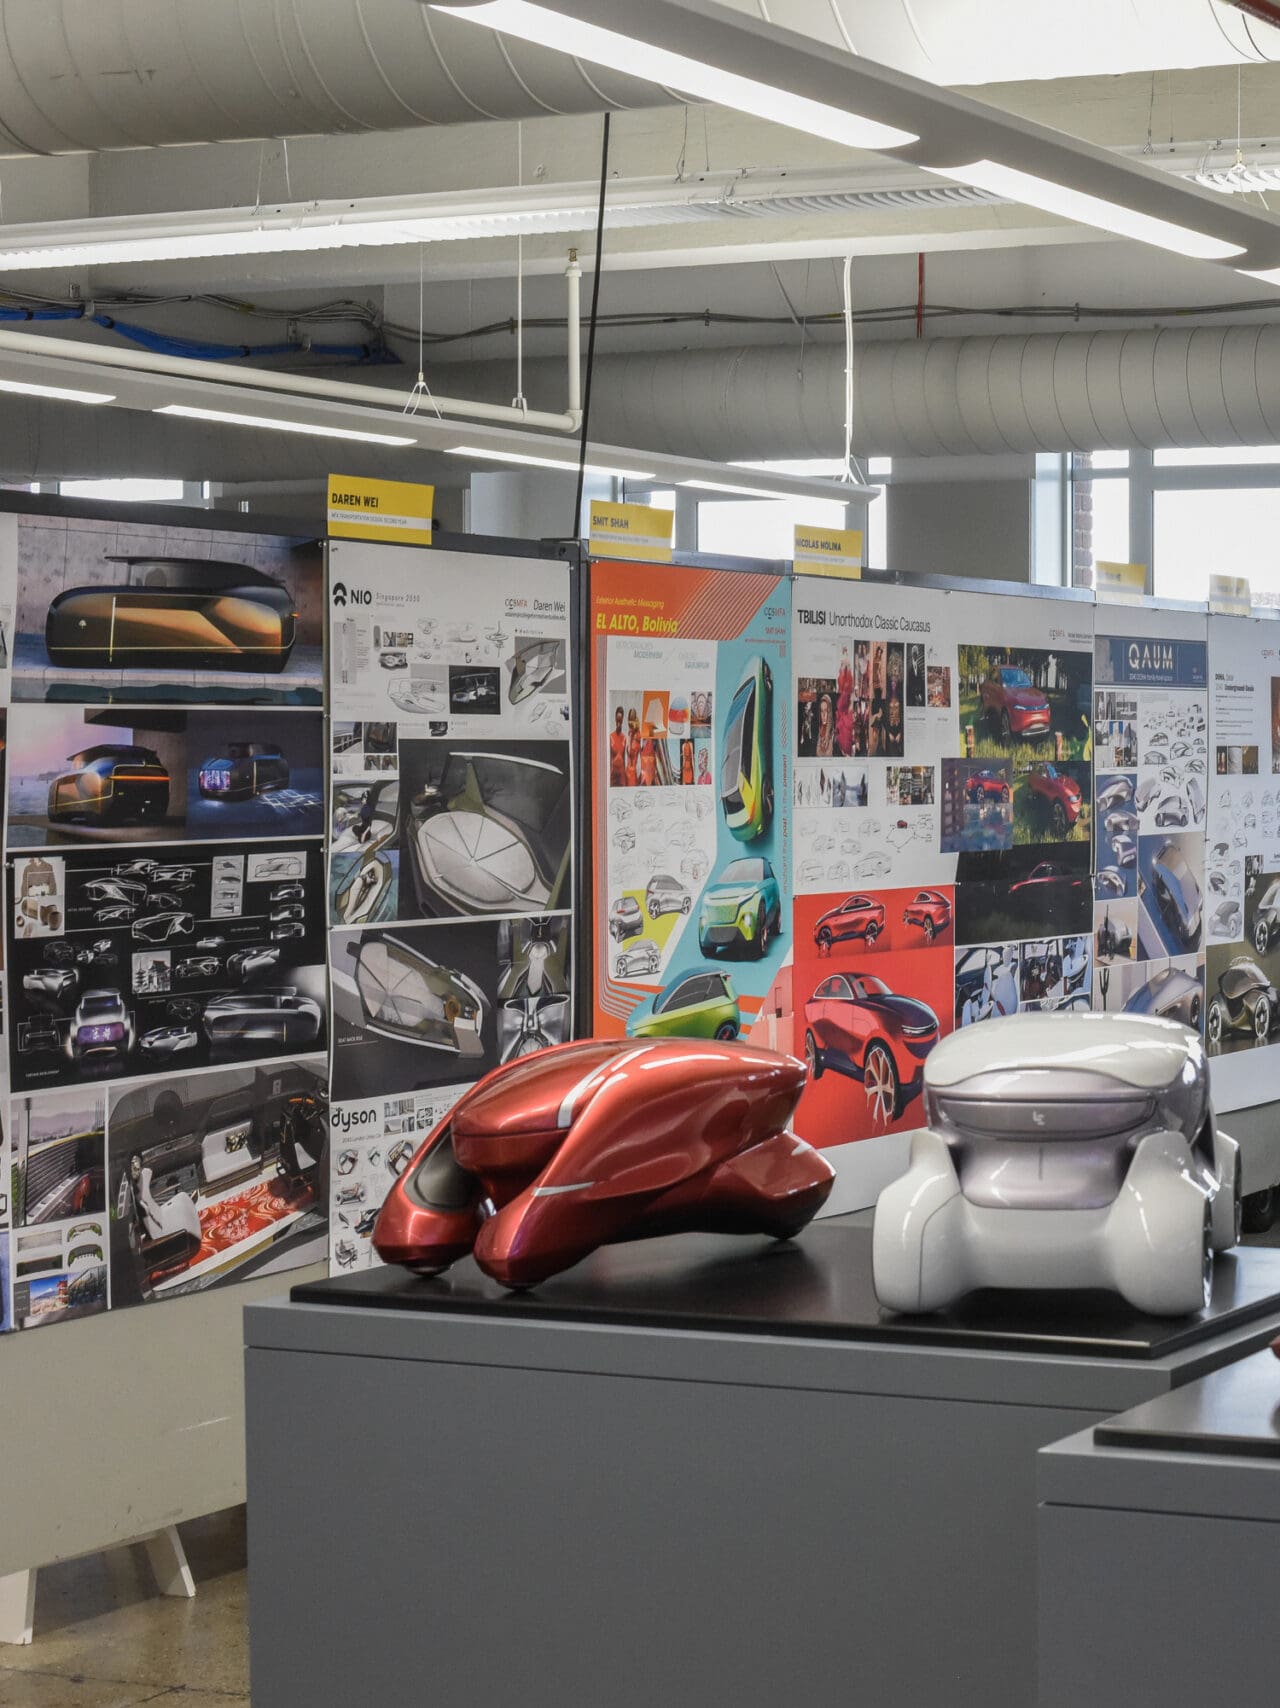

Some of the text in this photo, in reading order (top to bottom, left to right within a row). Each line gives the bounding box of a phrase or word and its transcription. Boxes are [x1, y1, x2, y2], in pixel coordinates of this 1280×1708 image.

[332, 493, 379, 508] DAREN WEI
[592, 515, 629, 528] SMIT SHAH
[820, 540, 842, 551] MOLINA
[350, 589, 372, 605] NIO
[533, 599, 553, 611] Daren
[553, 600, 566, 612] Wei
[596, 613, 679, 633] EL ALTO, Bolivia
[797, 609, 931, 633] TBILISI Unorthodox Classic Caucasus
[331, 1107, 377, 1133] dyson
